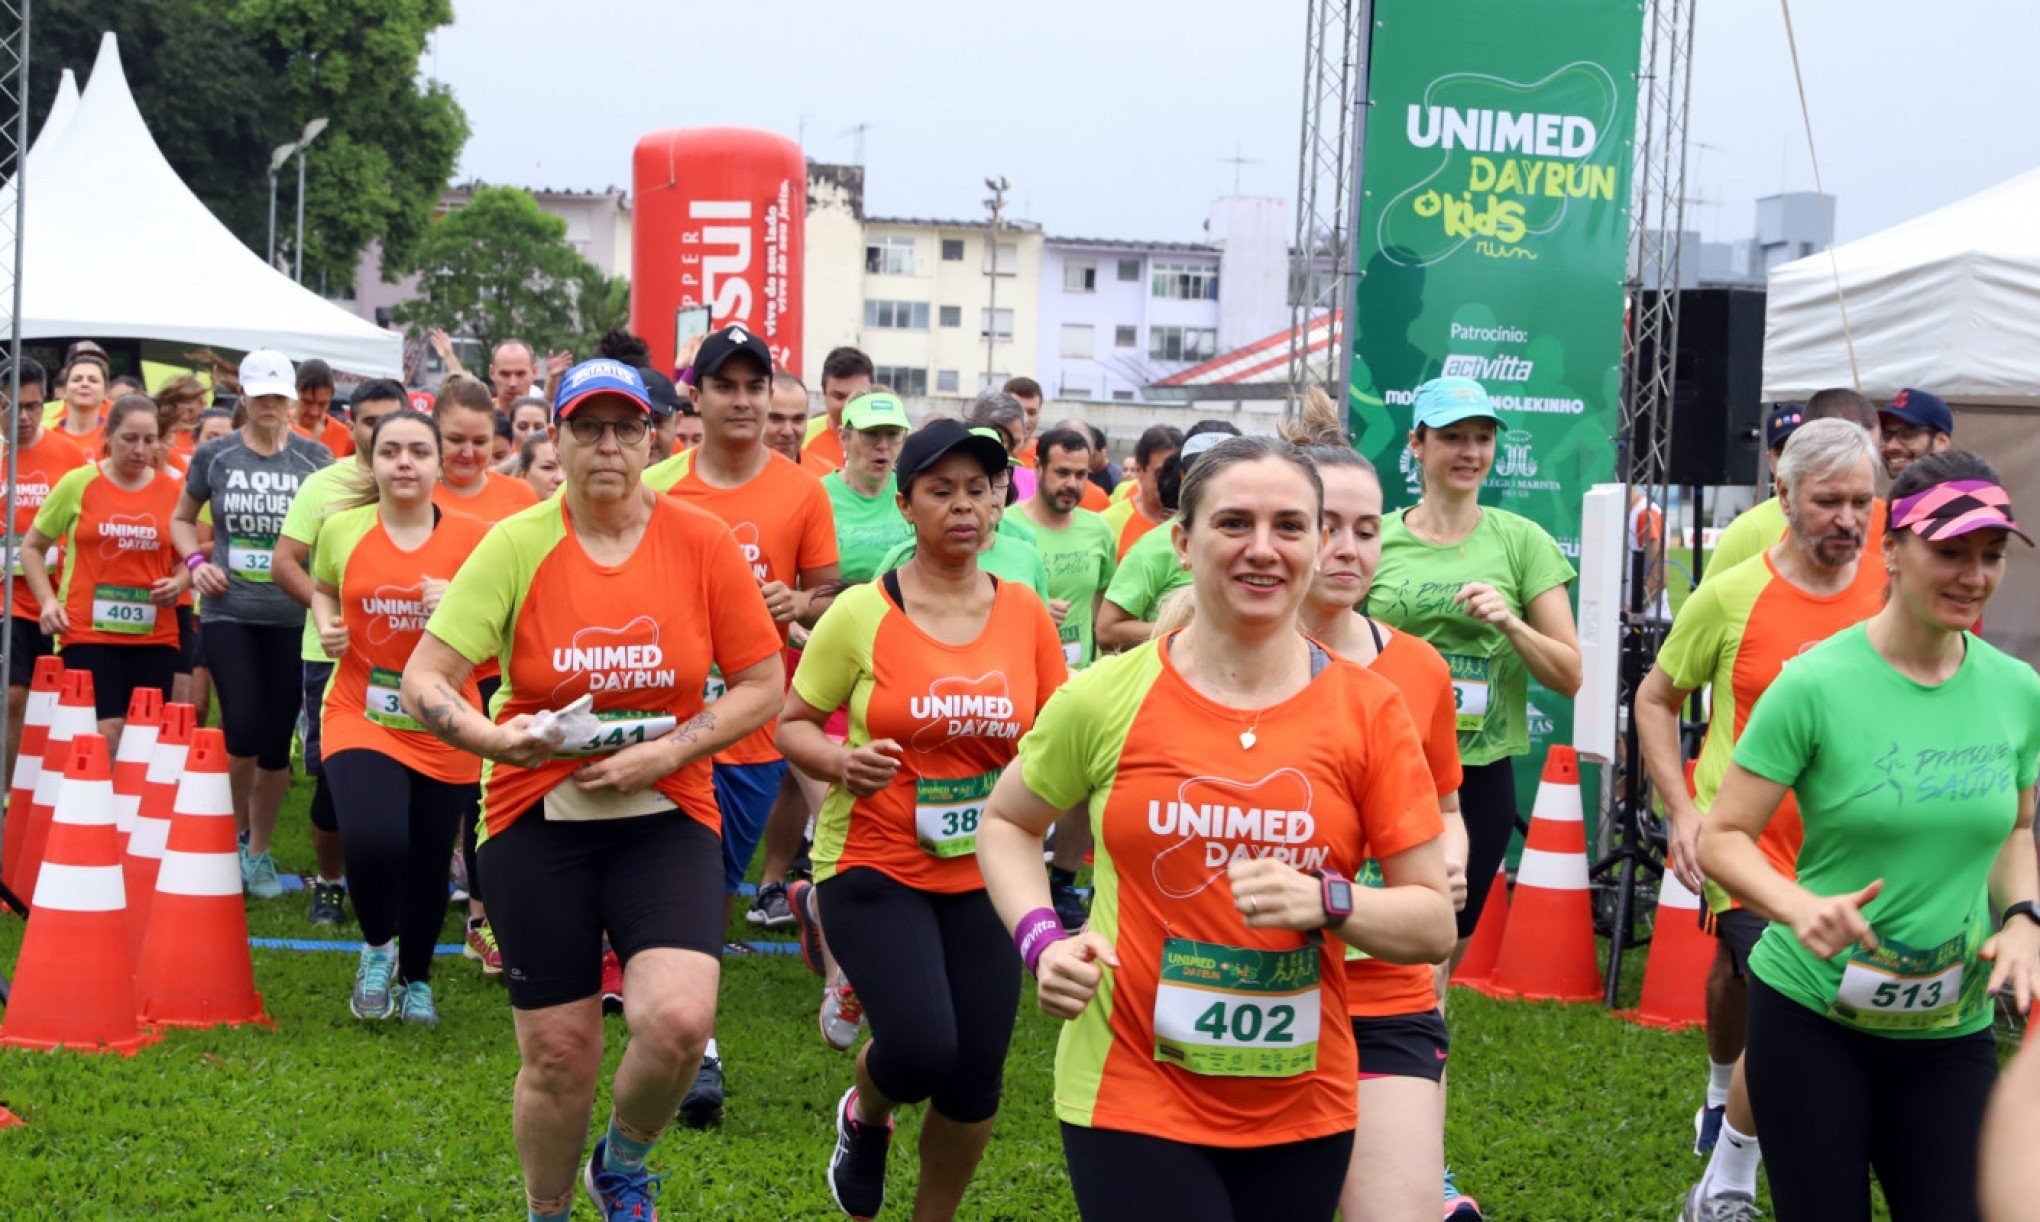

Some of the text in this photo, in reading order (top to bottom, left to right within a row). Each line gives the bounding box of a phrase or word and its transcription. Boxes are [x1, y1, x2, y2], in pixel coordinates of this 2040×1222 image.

[1406, 104, 1596, 158] UNIMED
[1469, 156, 1616, 200] DAYRUN
[1451, 322, 1528, 344] Patrocínio:
[98, 522, 158, 540] UNIMED
[245, 553, 270, 569] 32
[107, 605, 144, 621] 403
[552, 644, 663, 672] UNIMED
[589, 668, 675, 691] DAYRUN
[910, 694, 1014, 719] UNIMED
[947, 718, 1021, 739] DAYRUN
[941, 807, 983, 836] 38
[1148, 800, 1315, 844] UNIMED
[1168, 952, 1217, 970] UNIMED
[1870, 980, 1944, 1008] 513
[1194, 1001, 1296, 1043] 402
